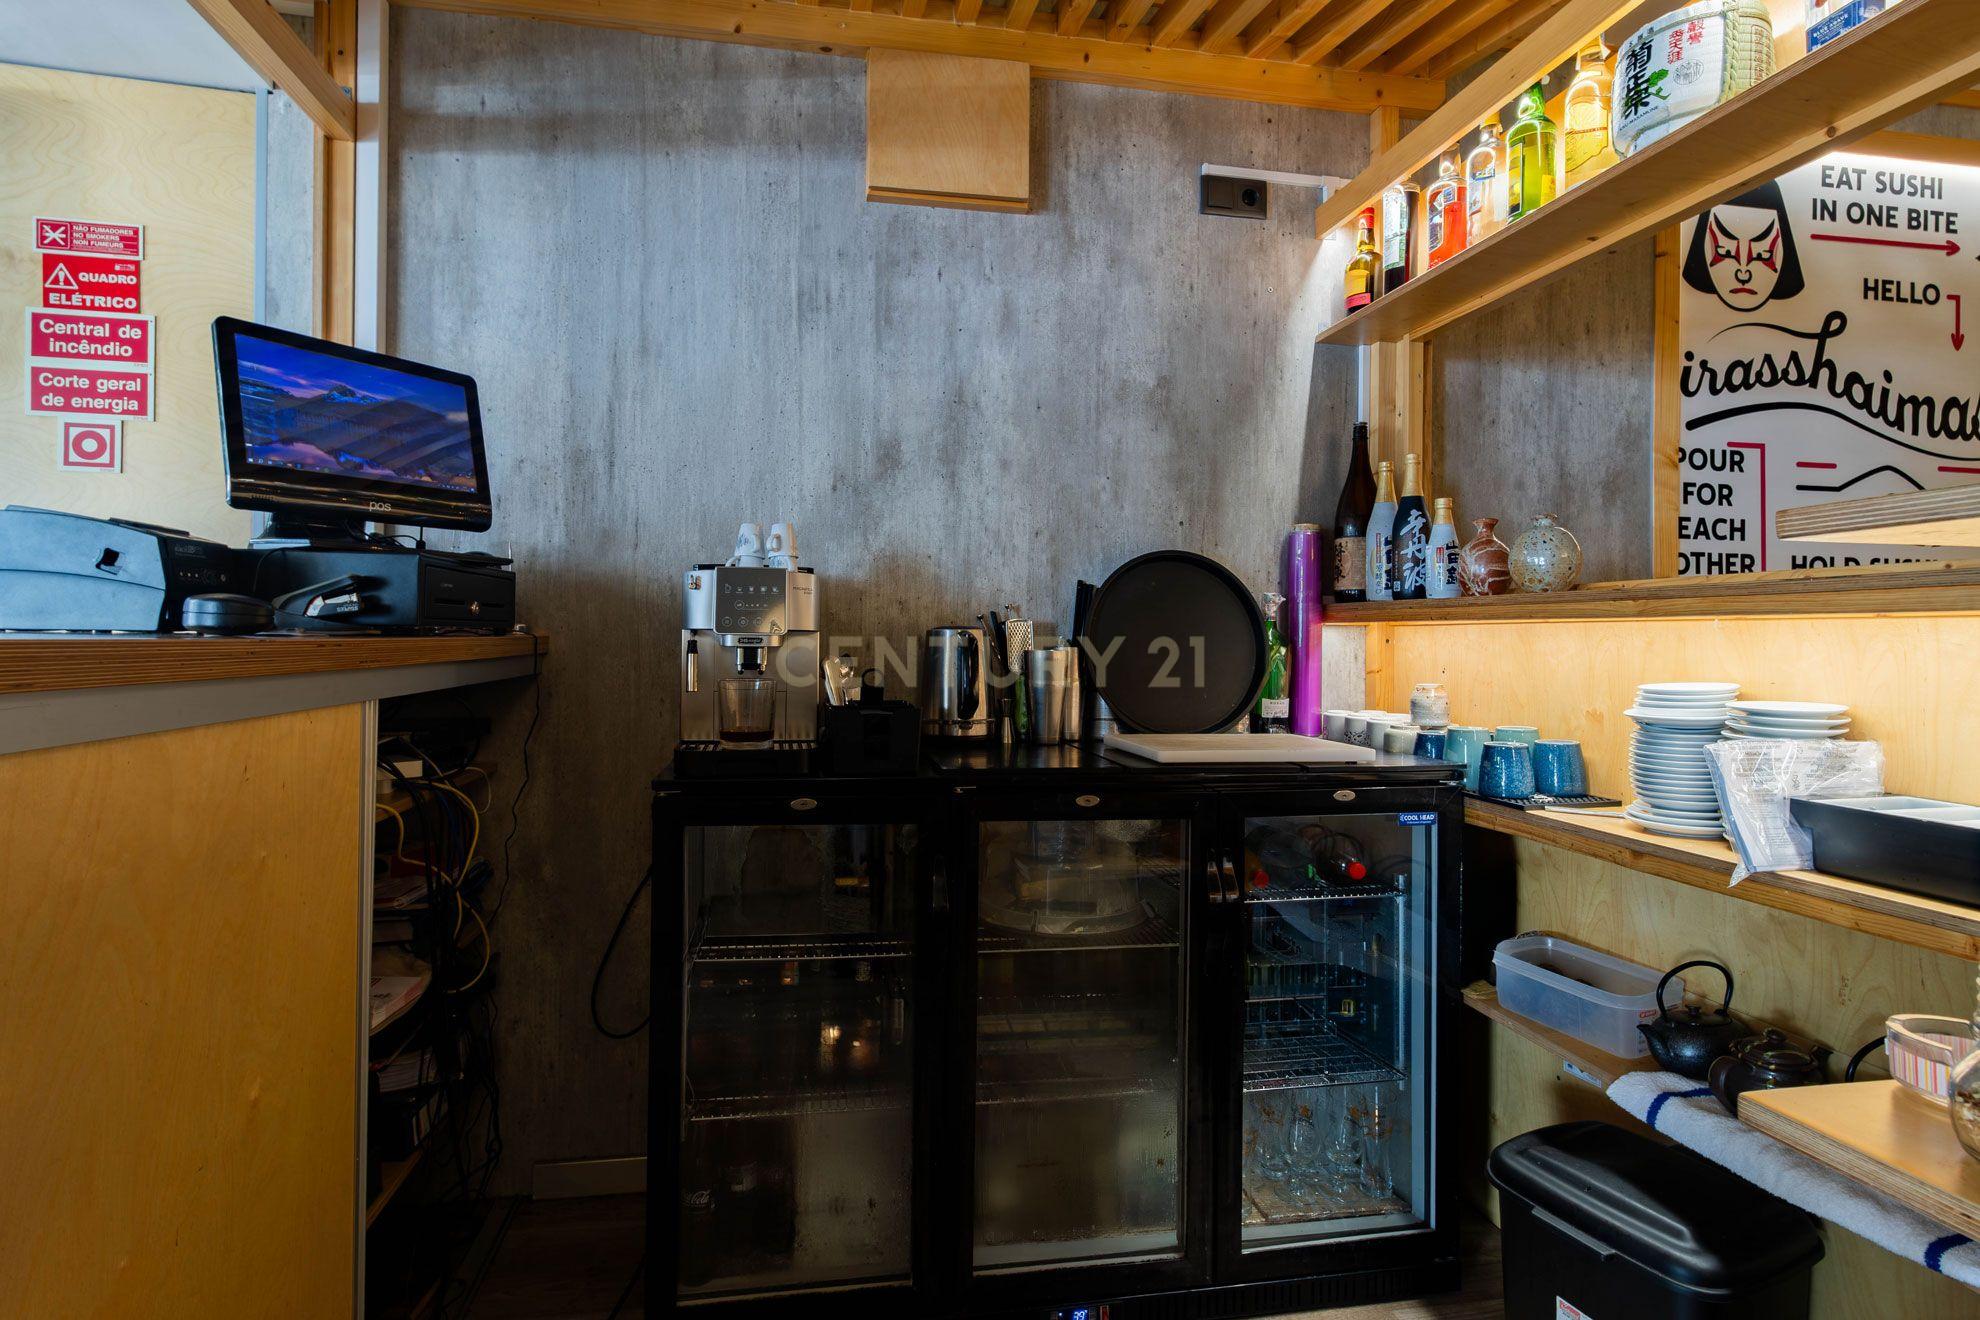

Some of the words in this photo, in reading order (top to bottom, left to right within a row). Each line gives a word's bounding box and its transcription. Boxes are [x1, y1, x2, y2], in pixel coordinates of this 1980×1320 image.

[1821, 164, 1867, 191] EAT
[1875, 170, 1944, 200] SUSHI
[1812, 198, 1837, 223] IN
[1846, 201, 1899, 229] ONE
[1907, 207, 1958, 235] BITE
[72, 224, 89, 233] NÃO
[90, 226, 134, 236] FUMADORES
[85, 233, 120, 242] SMOKERS
[72, 239, 89, 247] NON
[90, 240, 124, 250] FUMEURS
[78, 272, 138, 285] QUADRO
[48, 292, 137, 310] ELÉTRICO
[1863, 277, 1941, 306] HELLO
[39, 318, 110, 338] Central
[118, 324, 142, 340] de
[48, 338, 133, 357] incêndio
[38, 372, 90, 388] Corte
[96, 377, 141, 393] geral
[41, 392, 65, 407] de
[71, 396, 139, 413] energia
[1678, 447, 1745, 473] POUR
[1682, 482, 1734, 507] FOR
[369, 501, 392, 512] pos
[1678, 516, 1746, 541] EACH
[1678, 552, 1756, 576] OTHER
